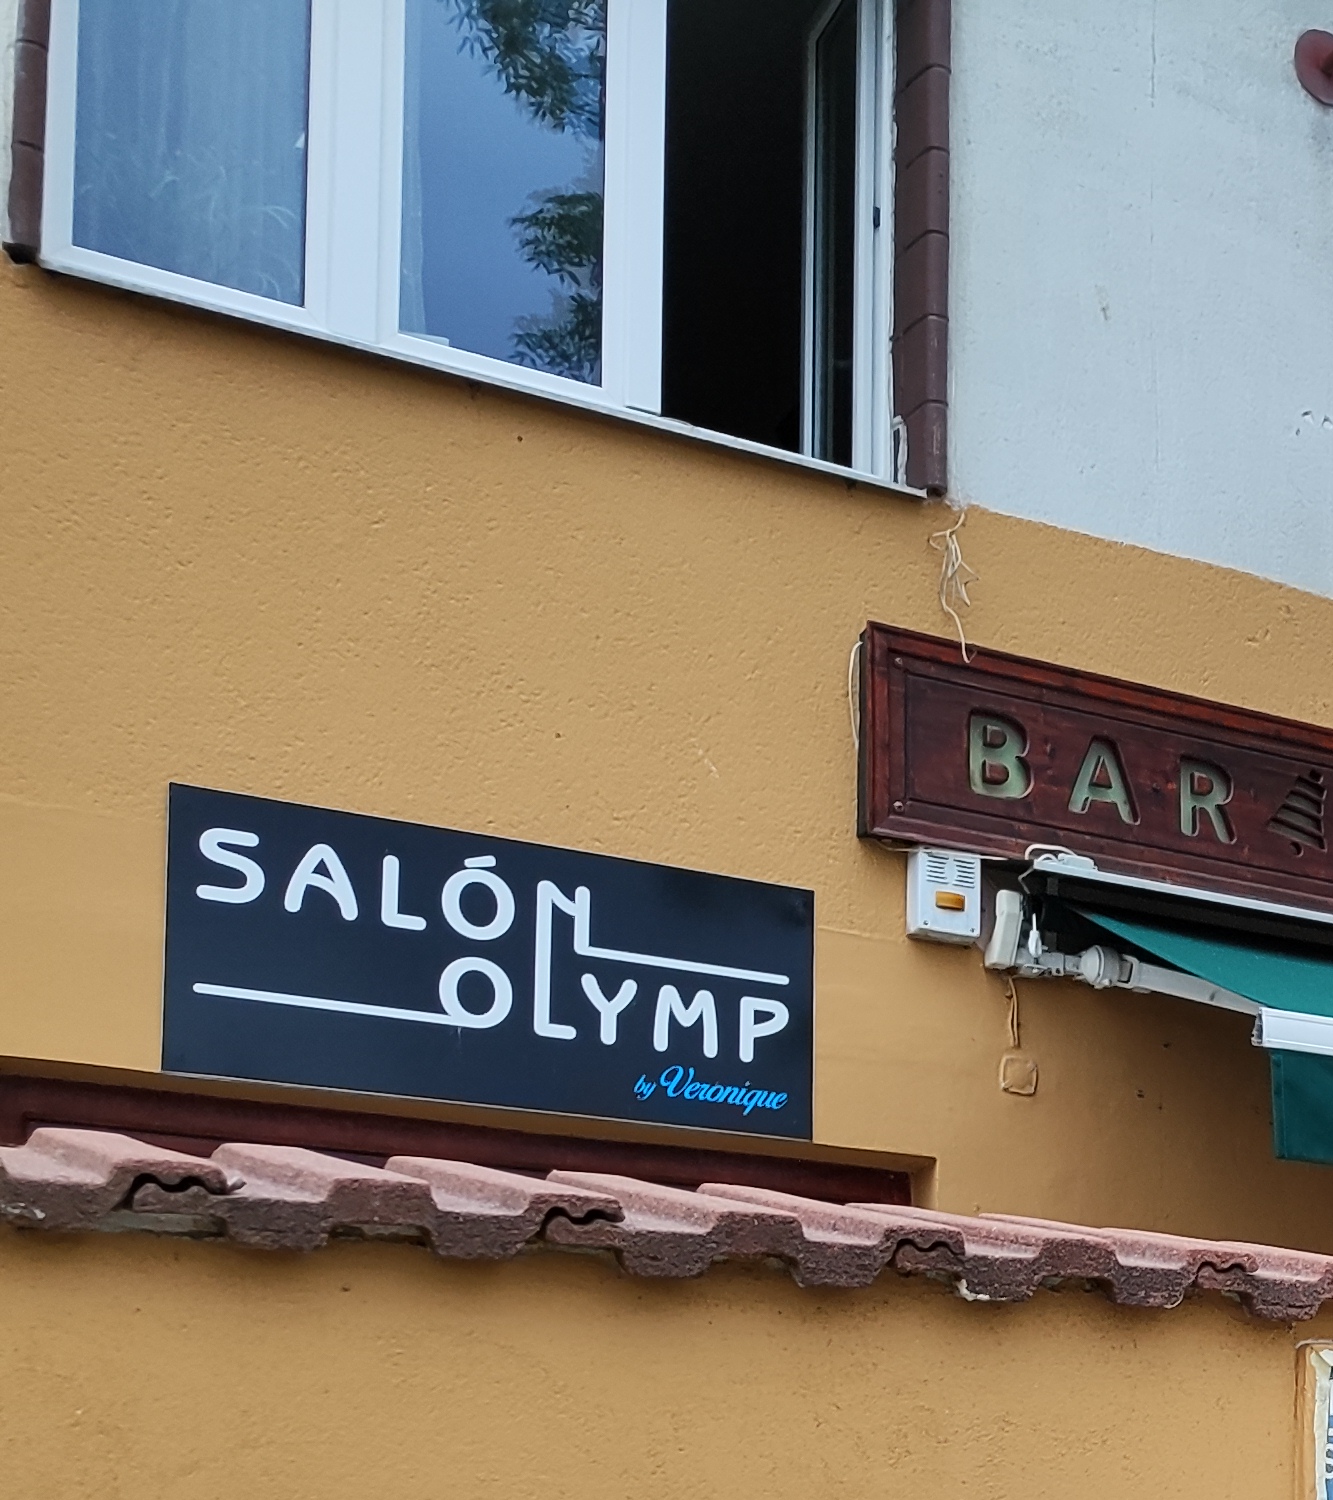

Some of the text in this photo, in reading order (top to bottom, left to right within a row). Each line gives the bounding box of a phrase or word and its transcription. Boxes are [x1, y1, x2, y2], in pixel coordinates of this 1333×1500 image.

[966, 709, 1238, 846] BAR
[196, 828, 591, 955] SALÓN
[438, 957, 790, 1063] OLYMP
[633, 1065, 788, 1116] by Veronique
